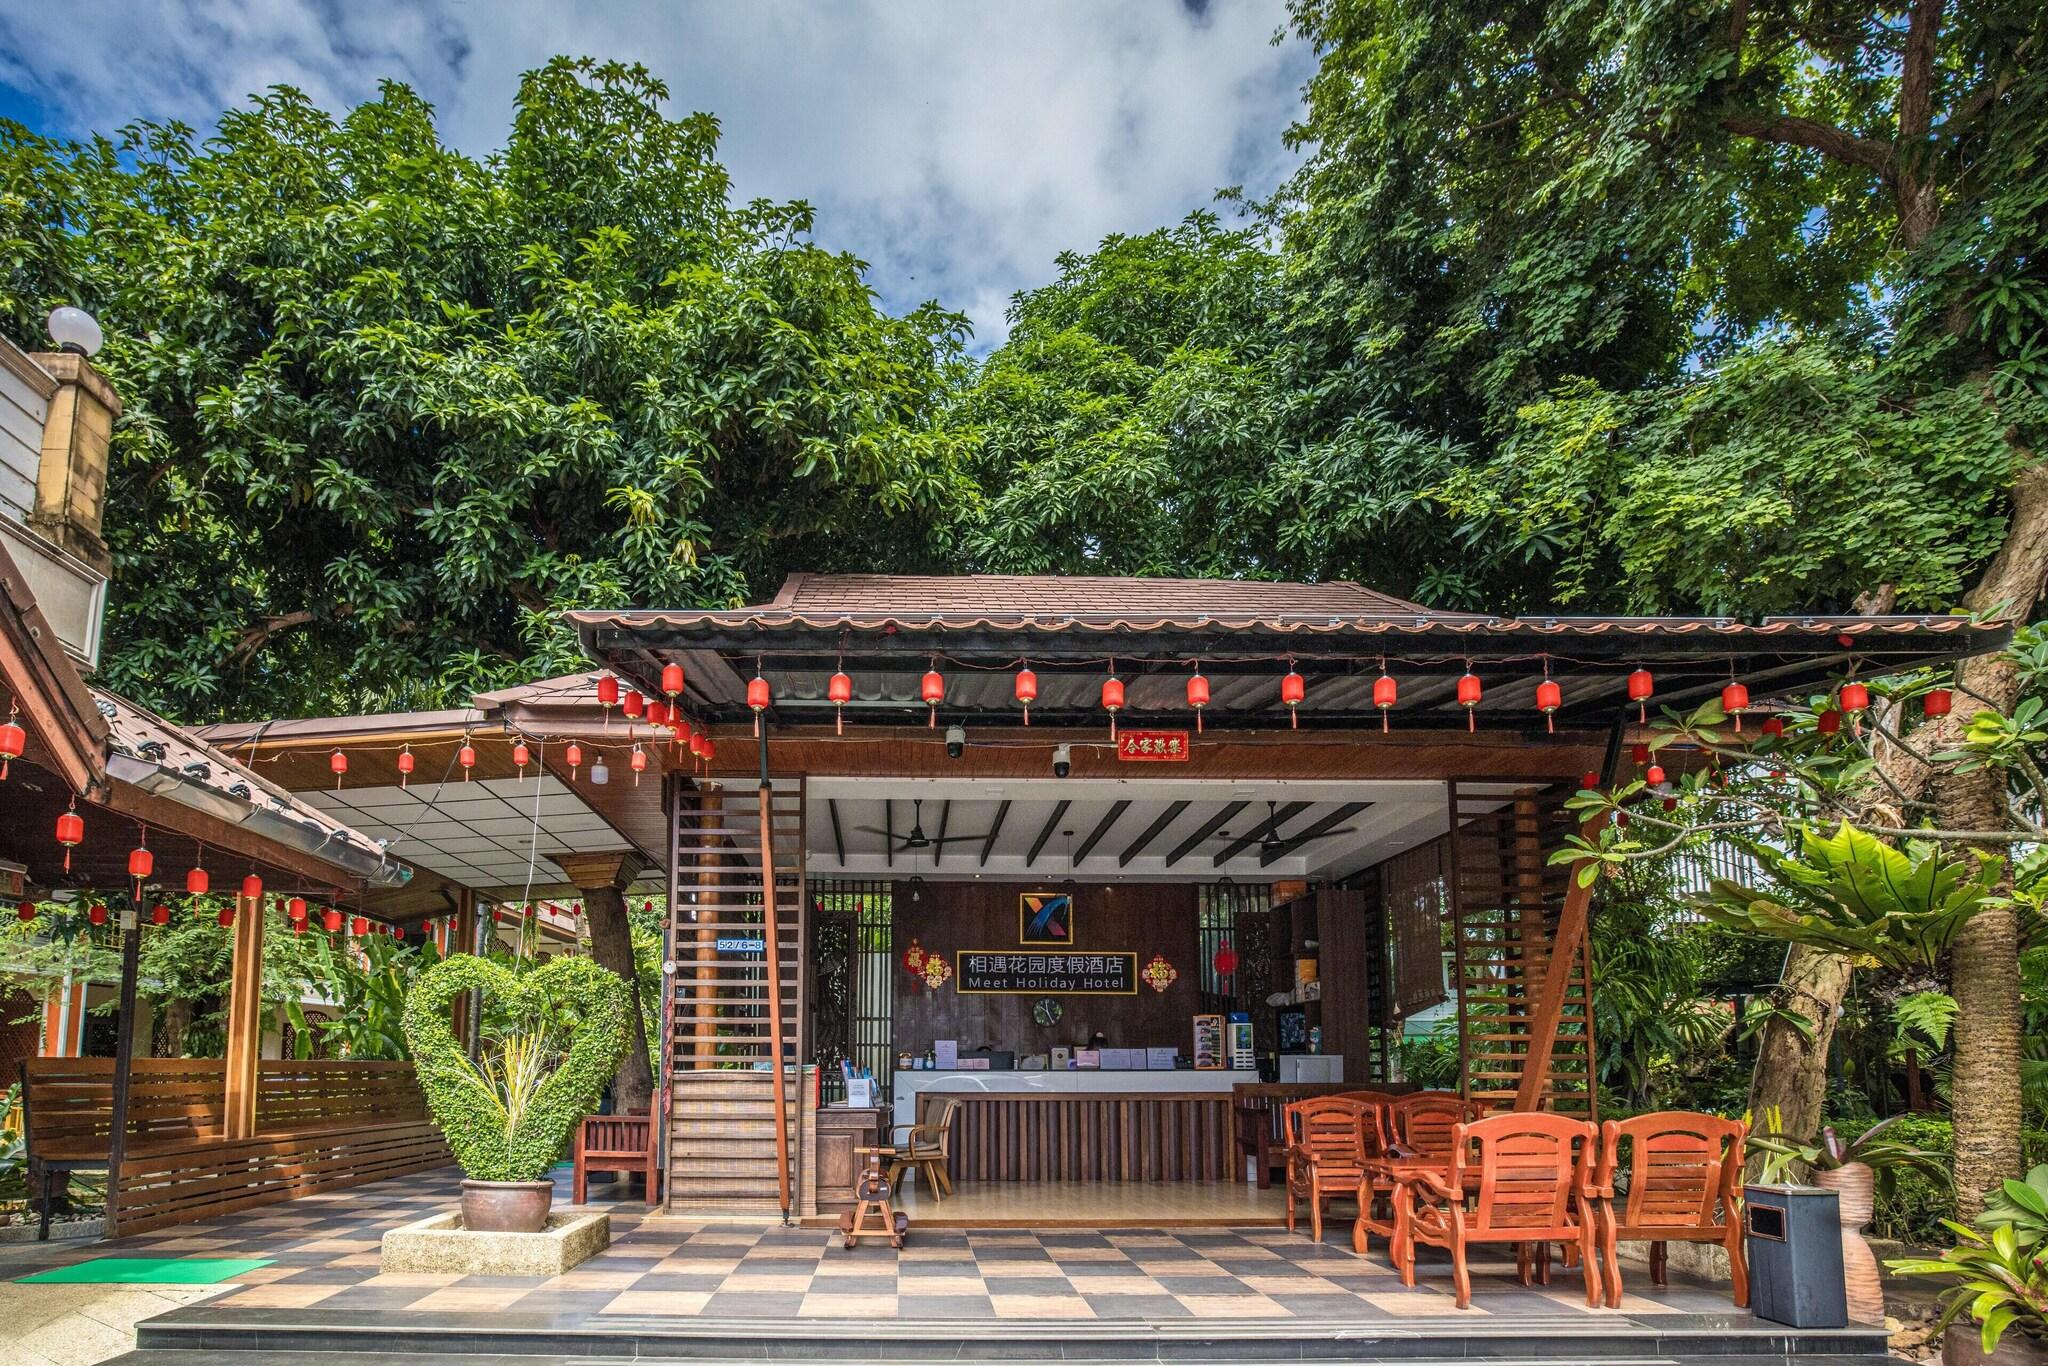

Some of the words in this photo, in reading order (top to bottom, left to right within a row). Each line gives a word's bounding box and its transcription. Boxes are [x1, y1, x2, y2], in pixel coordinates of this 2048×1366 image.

[719, 940, 761, 950] 52/6-8
[968, 955, 1125, 974] 相遇花园度假酒店
[968, 977, 1008, 988] Meet
[1016, 976, 1076, 991] Holiday
[1083, 977, 1124, 989] Hotel
